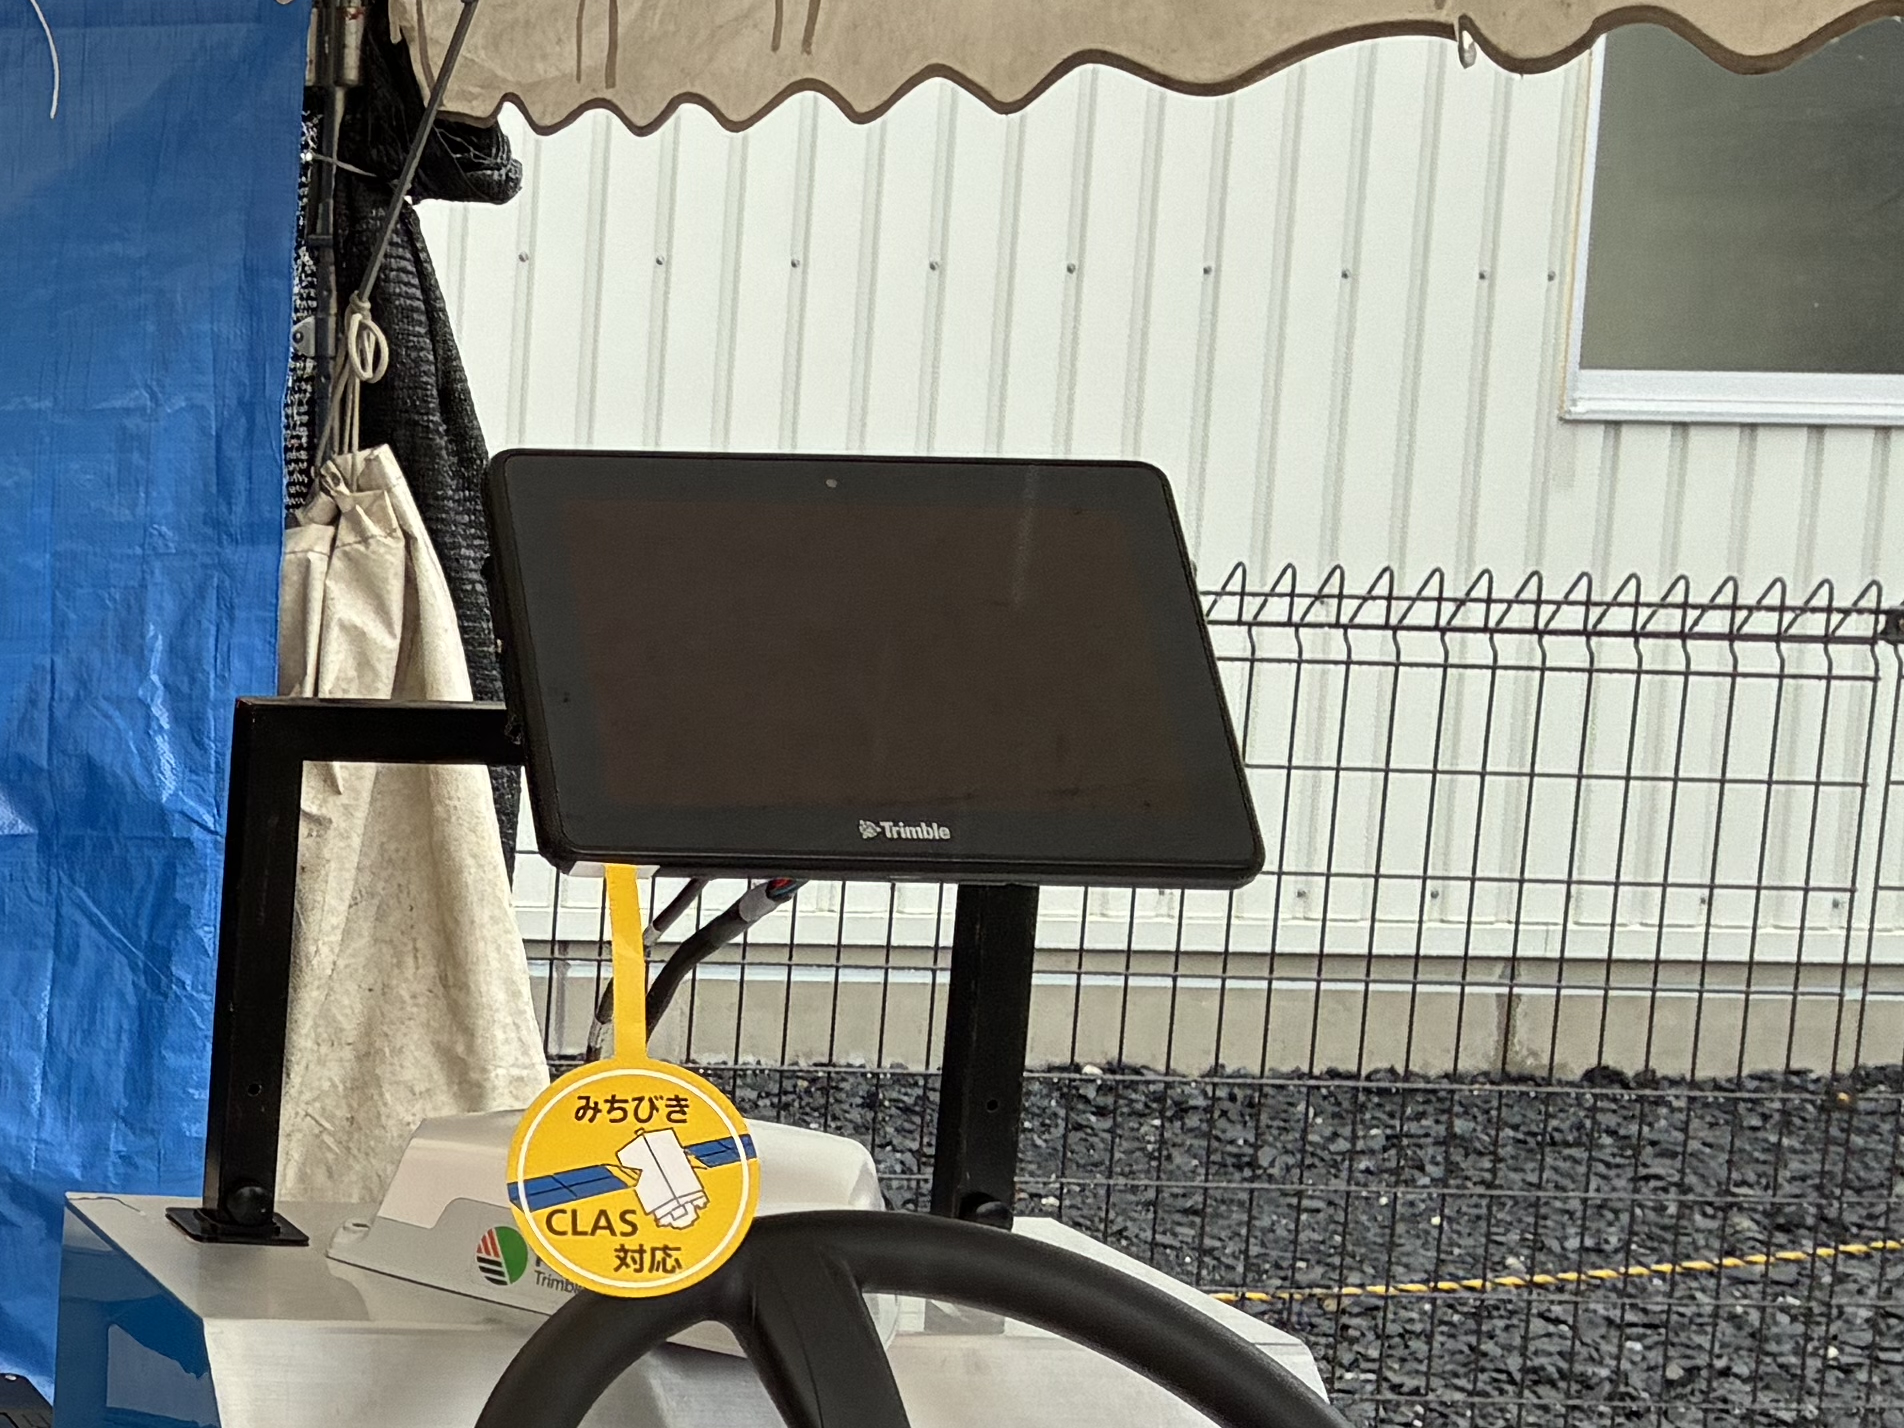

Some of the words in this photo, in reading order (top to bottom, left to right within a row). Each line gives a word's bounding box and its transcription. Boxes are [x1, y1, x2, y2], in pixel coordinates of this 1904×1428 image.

[879, 820, 952, 840] Trimble
[574, 1094, 691, 1124] みちびき
[545, 1208, 639, 1238] CLAS
[613, 1243, 683, 1275] 対応
[534, 1269, 583, 1293] Trimbl
